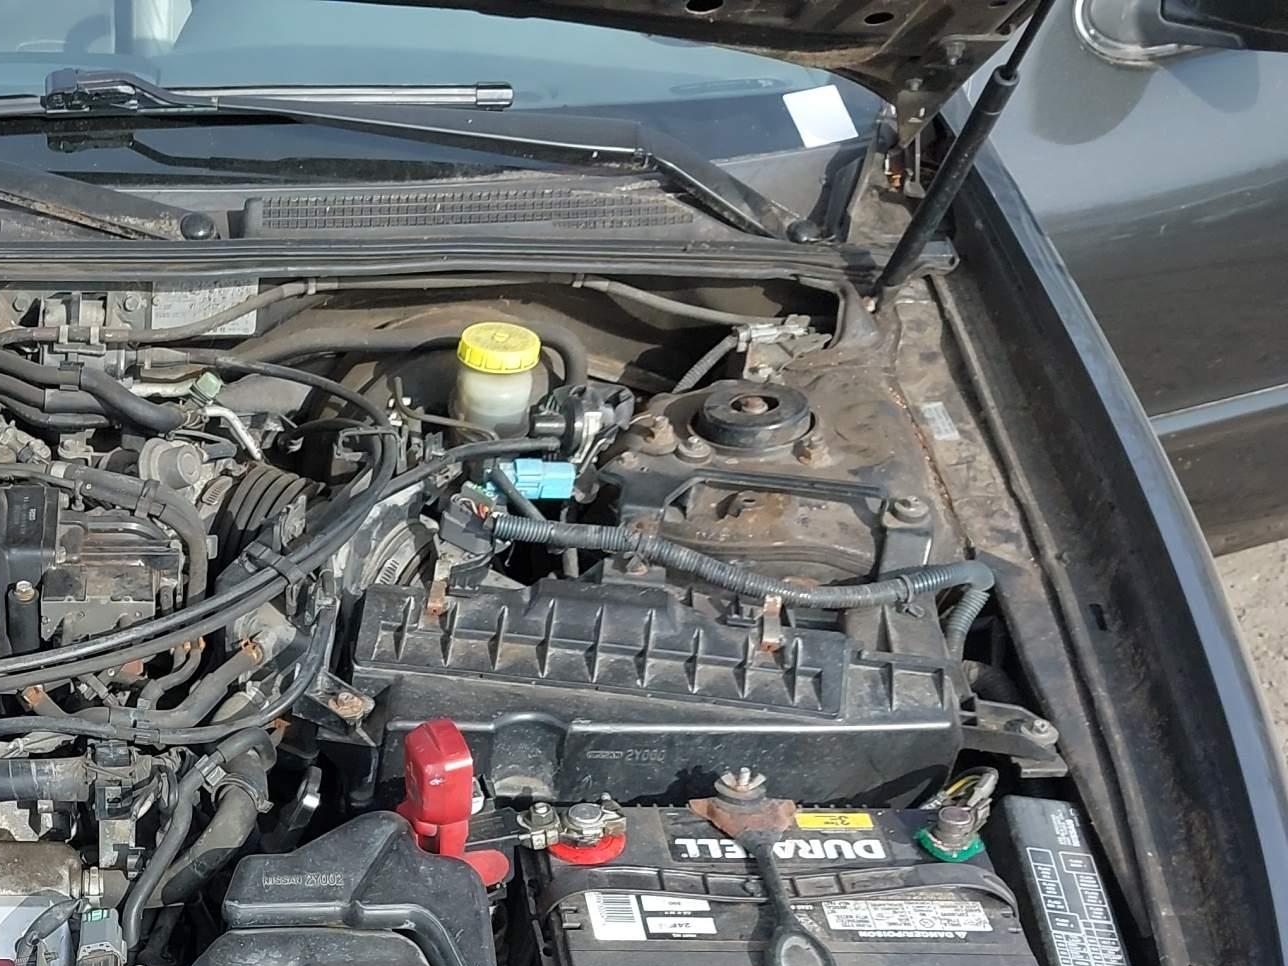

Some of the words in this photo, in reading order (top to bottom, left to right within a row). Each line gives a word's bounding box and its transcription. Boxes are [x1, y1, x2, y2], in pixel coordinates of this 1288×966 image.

[838, 815, 851, 826] 3
[675, 838, 887, 860] DURAELL
[262, 875, 303, 887] NISSAN
[304, 872, 344, 887] 2Y002
